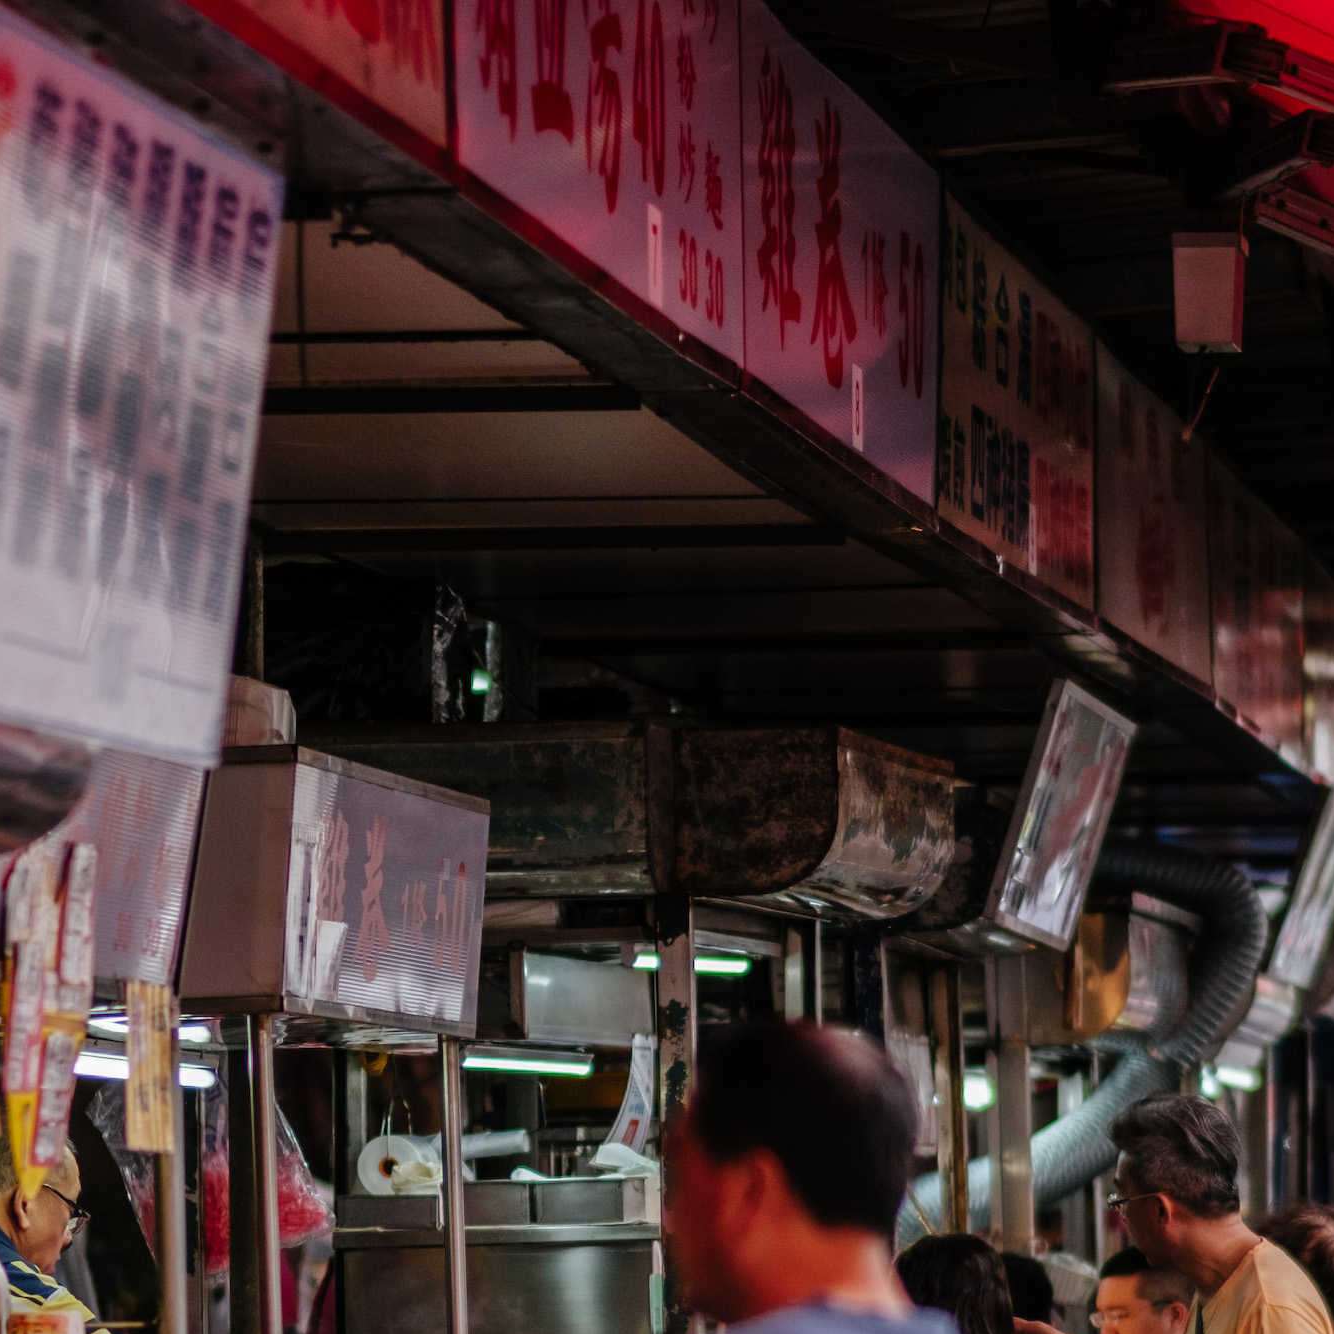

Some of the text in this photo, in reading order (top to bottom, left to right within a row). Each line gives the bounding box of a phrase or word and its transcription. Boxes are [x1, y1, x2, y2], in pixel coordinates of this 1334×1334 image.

[678, 227, 698, 310] 30
[704, 249, 725, 329] 30
[898, 229, 925, 400] 50
